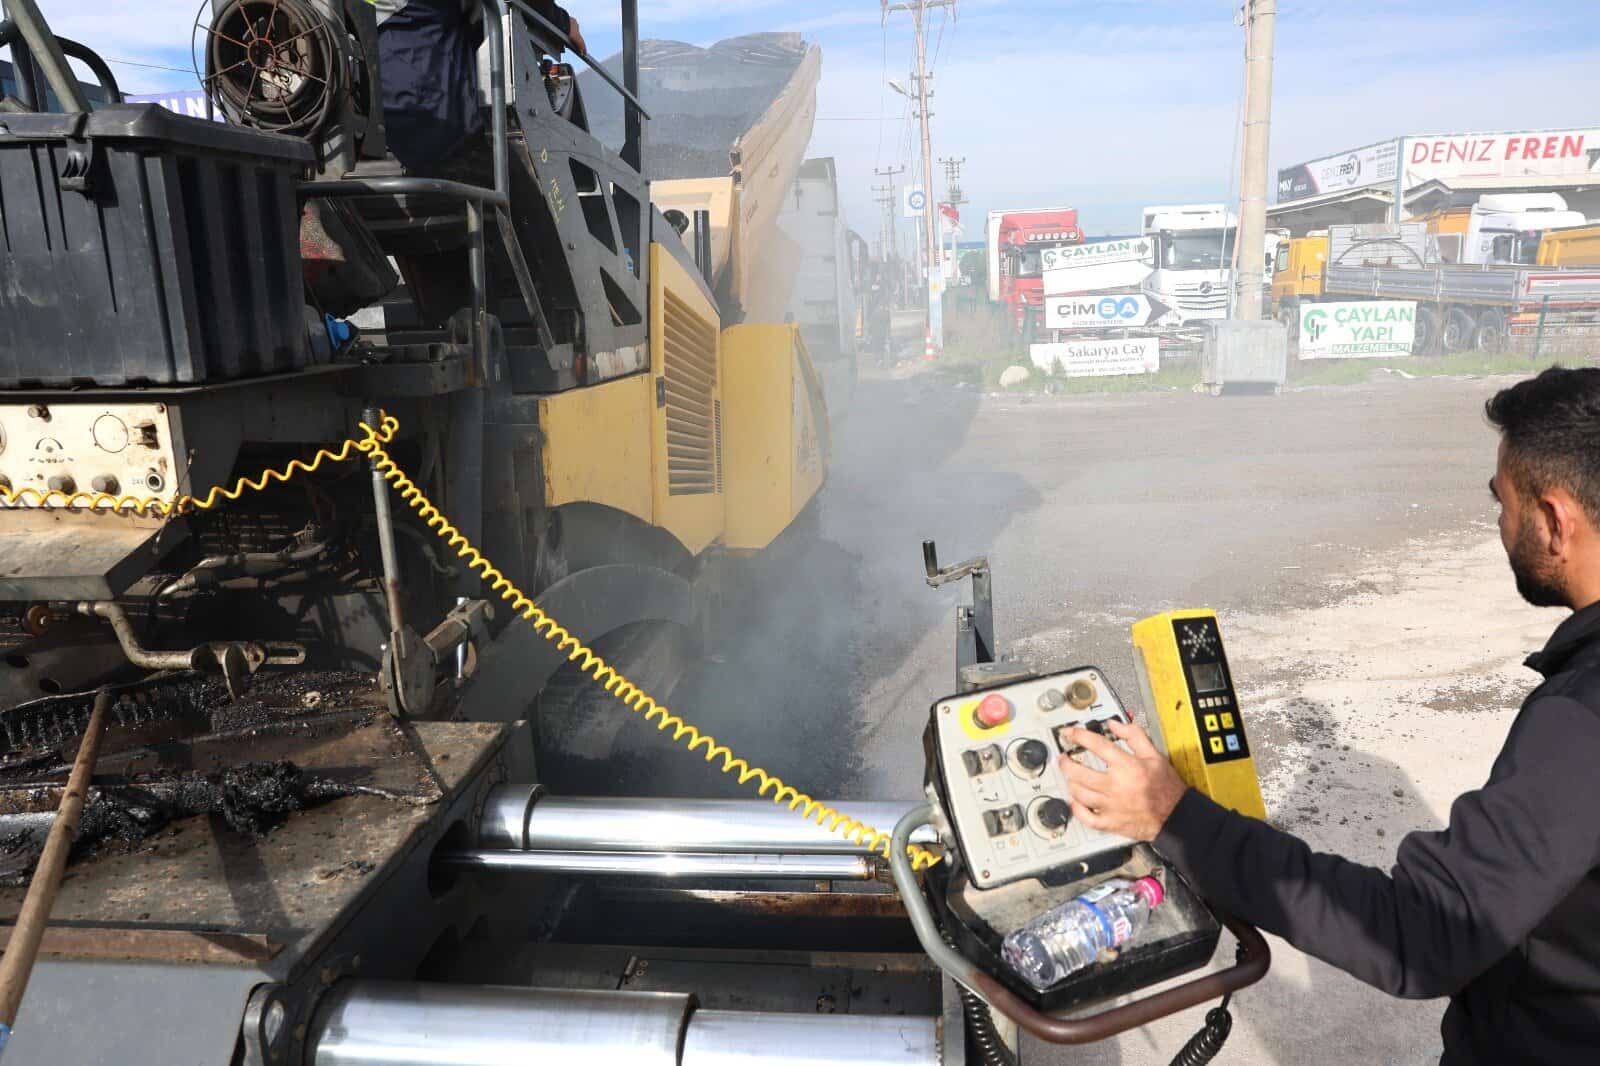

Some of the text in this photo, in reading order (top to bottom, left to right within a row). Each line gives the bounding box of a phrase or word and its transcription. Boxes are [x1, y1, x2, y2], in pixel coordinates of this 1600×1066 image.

[1504, 135, 1585, 160] FREN
[1334, 307, 1413, 328] ÇAYLAN
[1350, 326, 1393, 341] YAPI
[1067, 344, 1119, 360] Sakarya
